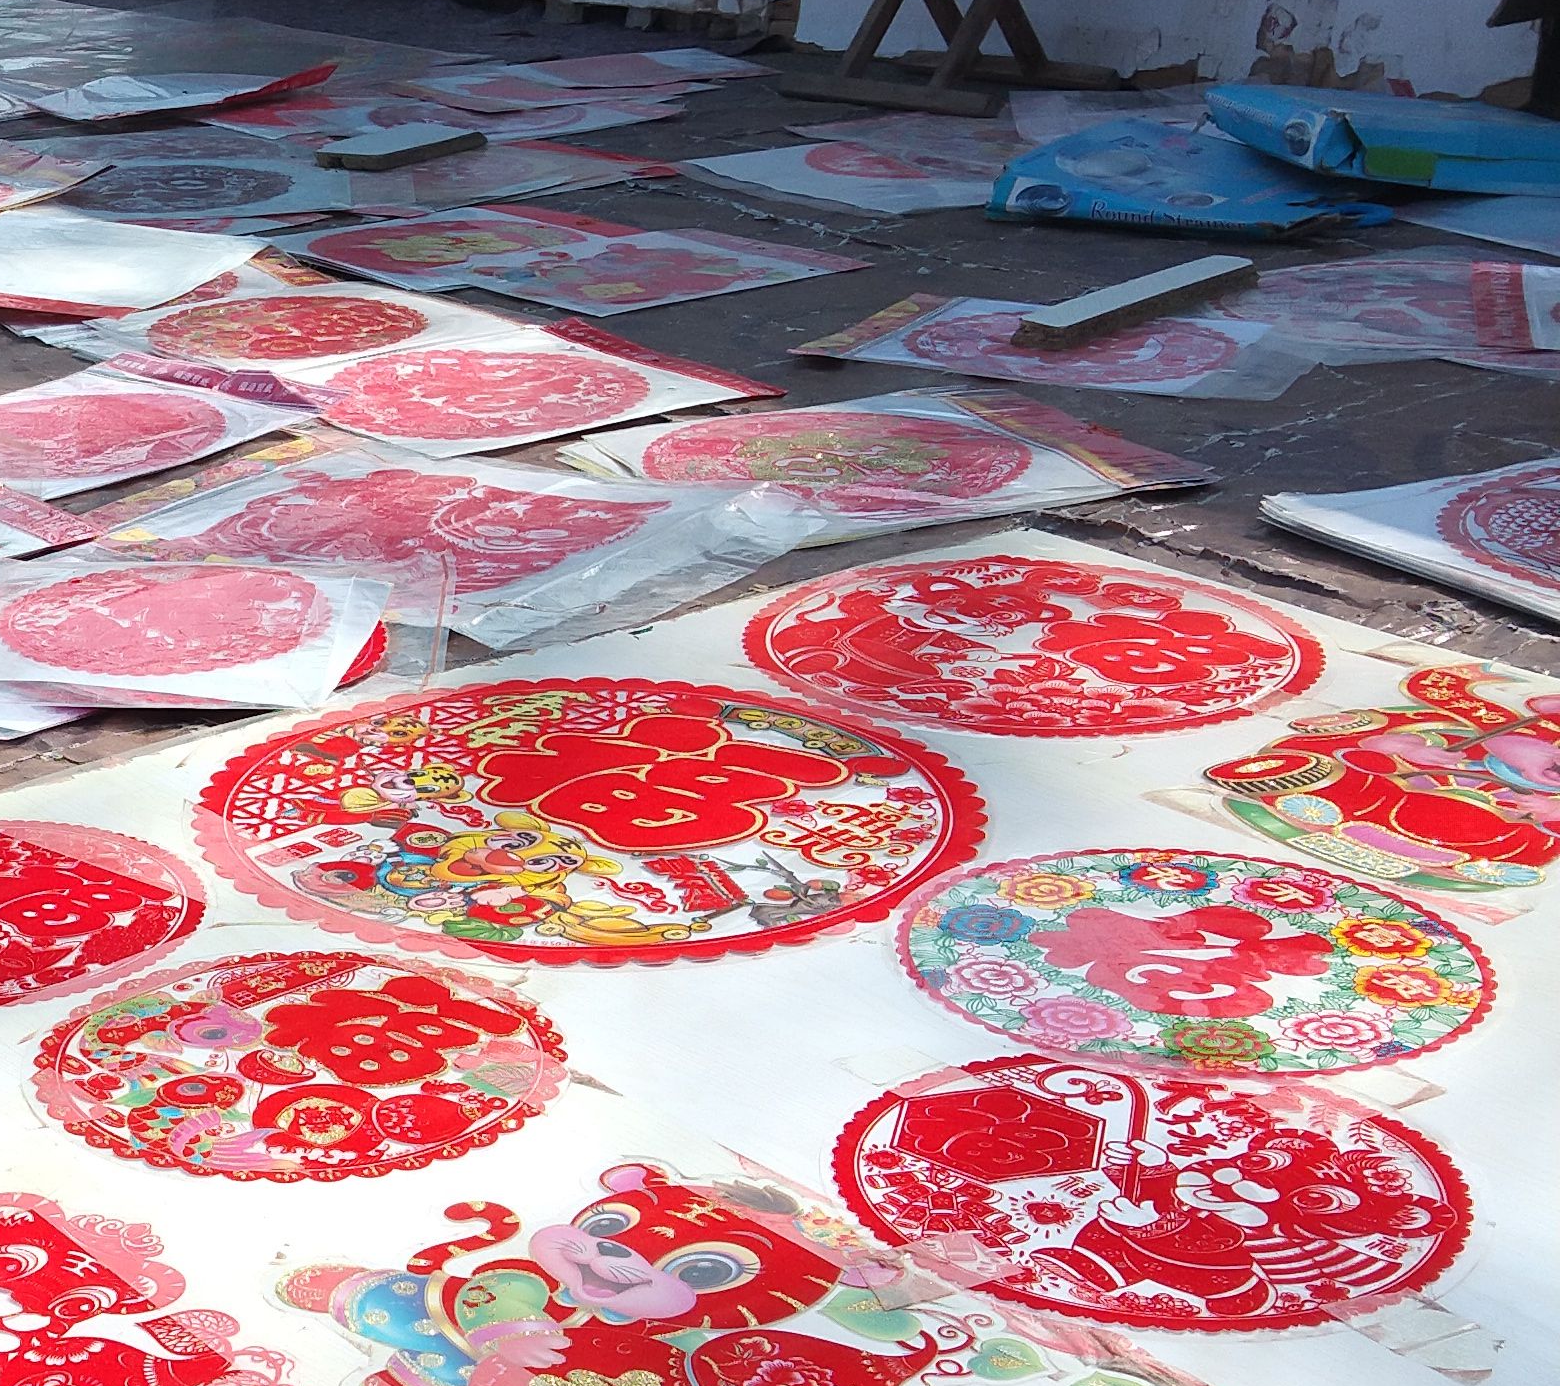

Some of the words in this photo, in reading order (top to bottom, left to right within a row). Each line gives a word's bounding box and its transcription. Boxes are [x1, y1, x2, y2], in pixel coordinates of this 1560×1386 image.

[1032, 611, 1293, 686] 福
[477, 714, 849, 851] 福
[262, 975, 528, 1087] 福
[1051, 1173, 1107, 1202] 福
[60, 1249, 100, 1279] 王
[1362, 1233, 1408, 1260] 福
